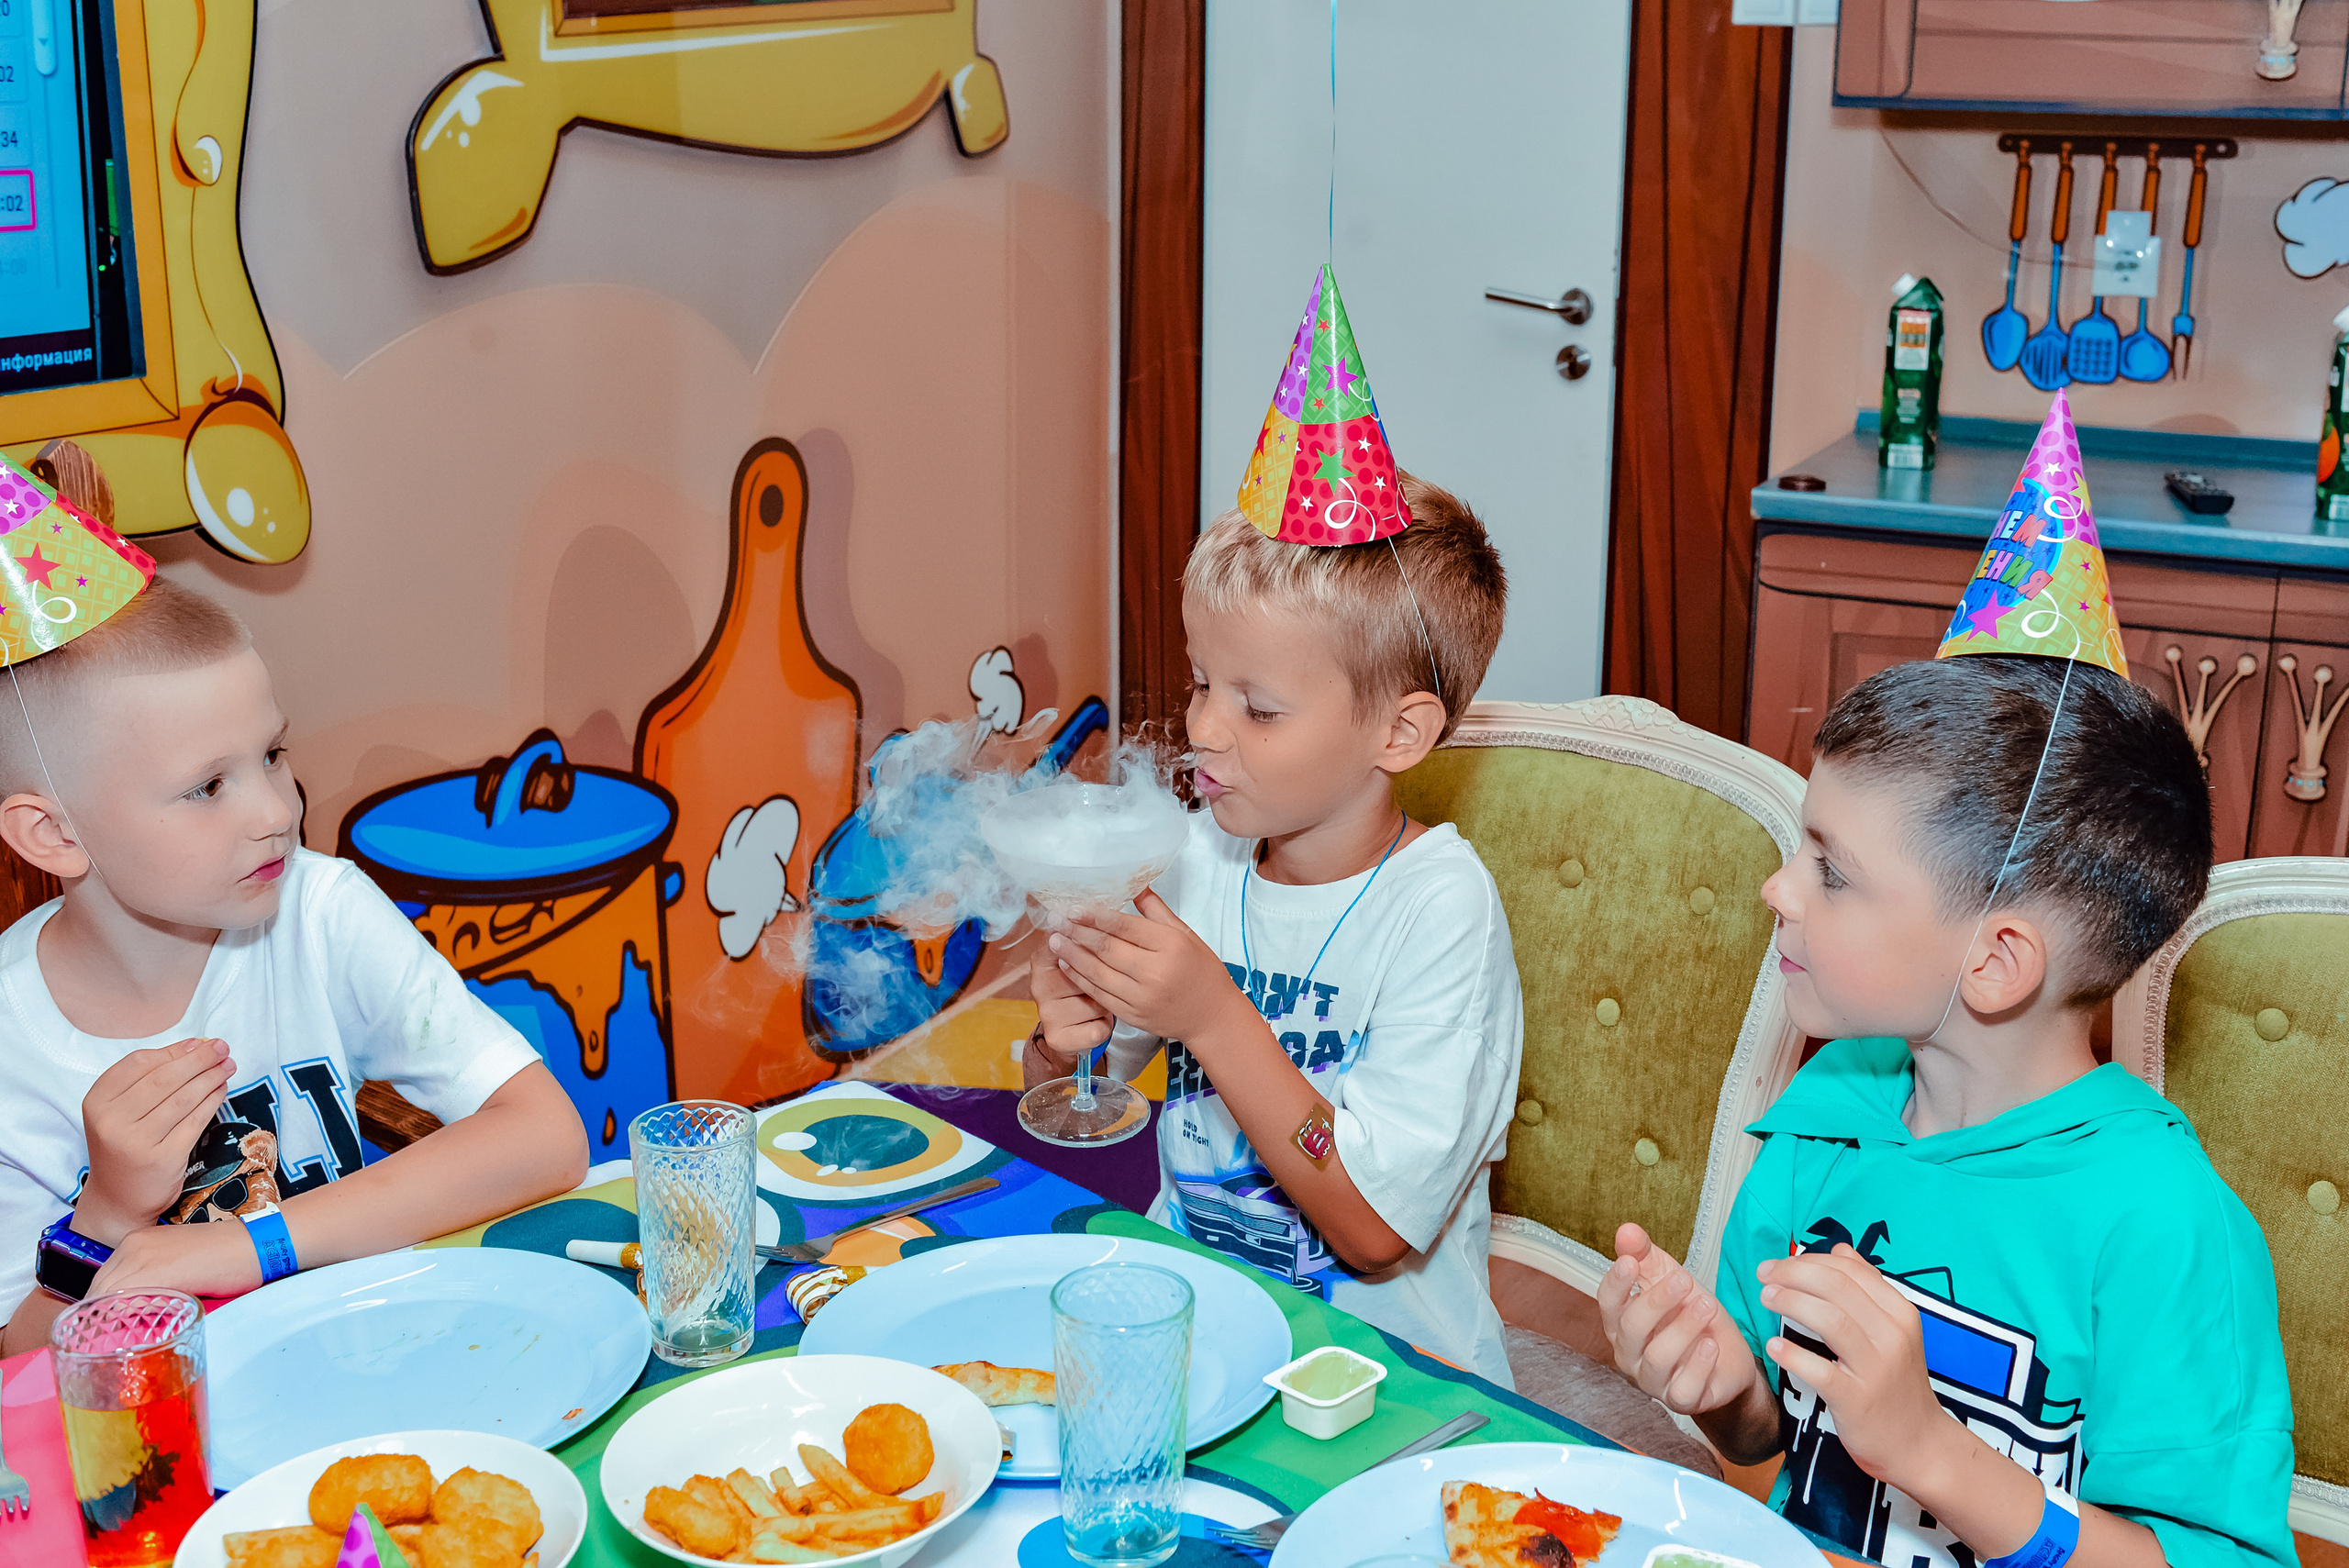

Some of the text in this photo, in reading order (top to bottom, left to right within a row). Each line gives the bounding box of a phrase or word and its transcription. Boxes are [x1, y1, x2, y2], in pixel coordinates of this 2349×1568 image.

[0, 0, 11, 17] 0
[0, 347, 93, 373] нформация
[1970, 548, 2054, 602] ЕНИЯ
[1183, 1118, 1197, 1133] HOLD
